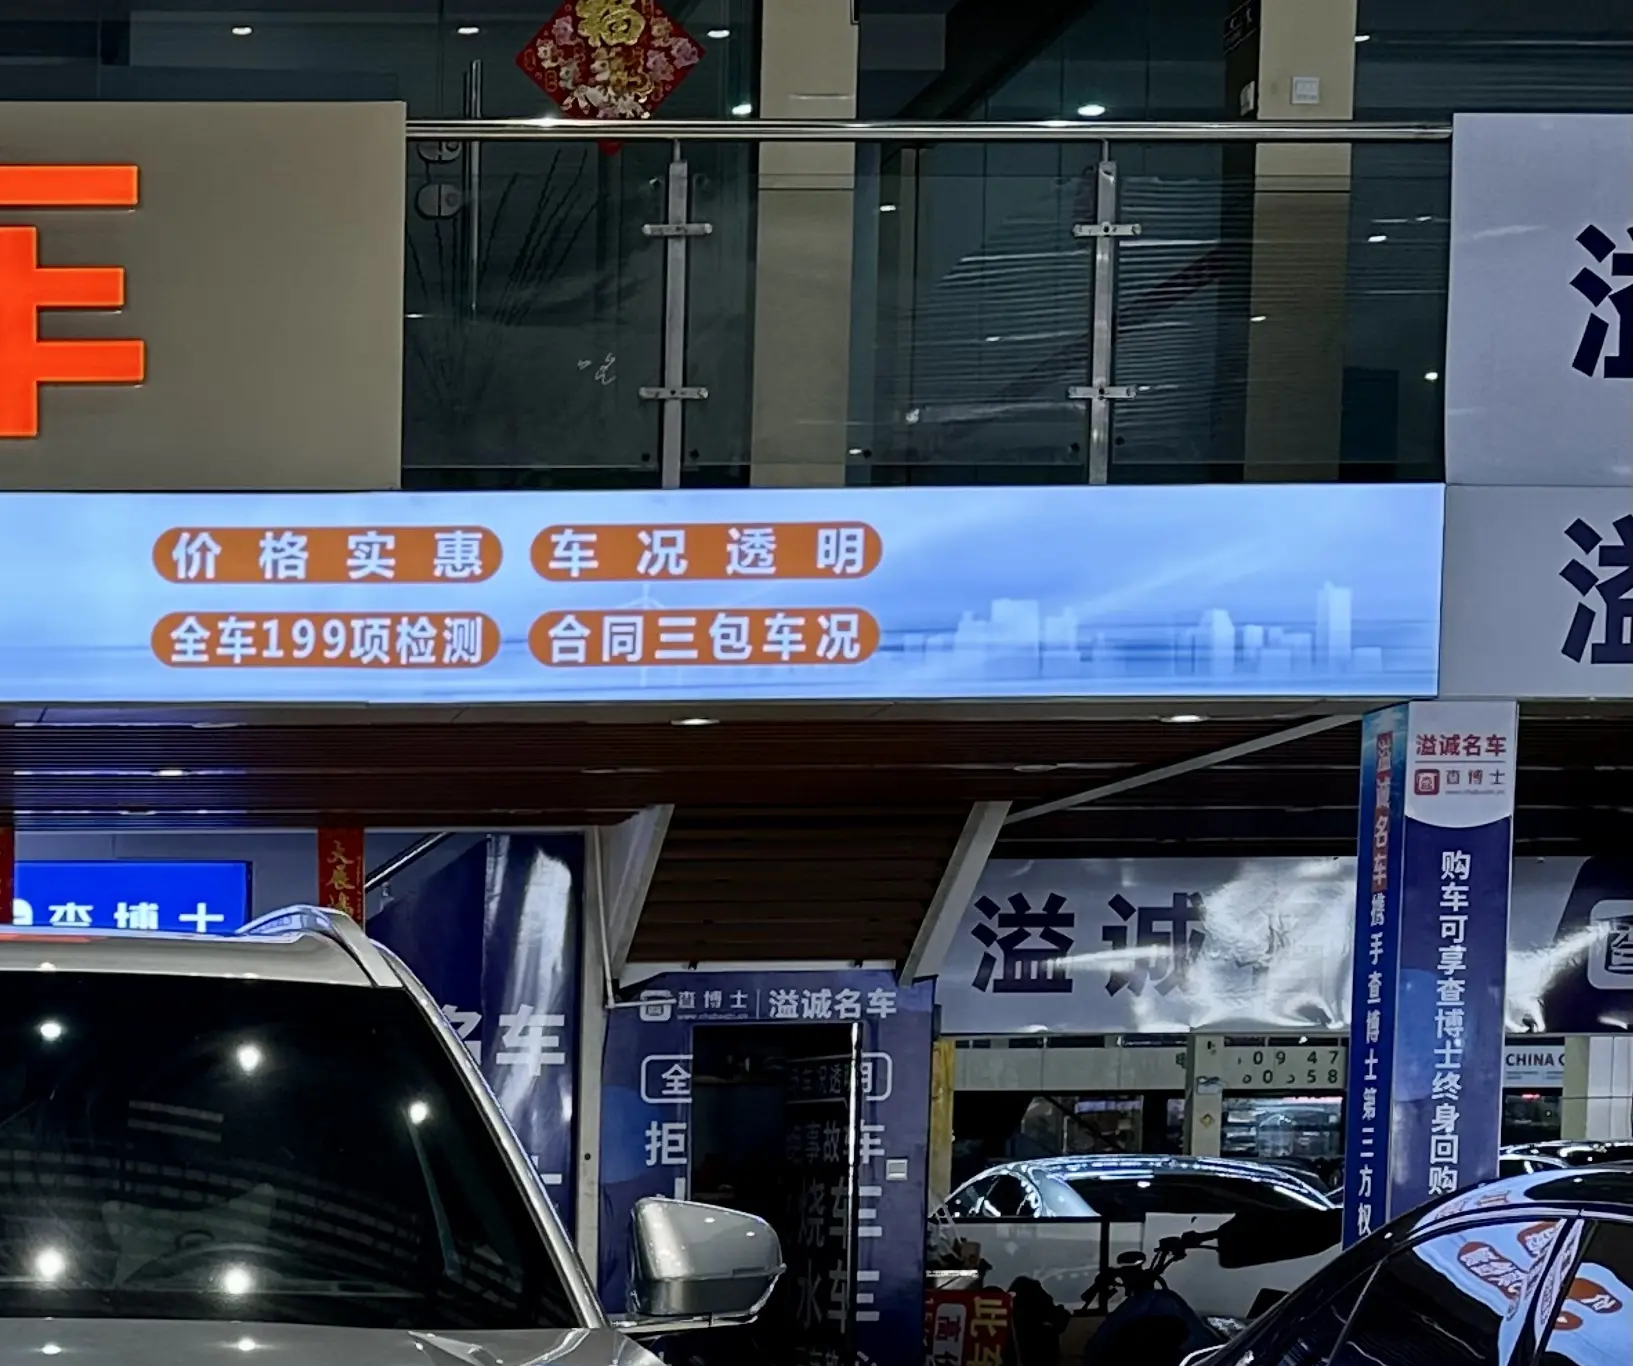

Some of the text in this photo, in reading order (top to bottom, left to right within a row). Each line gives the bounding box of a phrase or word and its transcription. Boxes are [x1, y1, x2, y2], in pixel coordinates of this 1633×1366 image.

[172, 531, 483, 579] 价格实惠
[549, 528, 865, 577] 车况透明
[170, 614, 484, 665] 全车199项检测
[548, 612, 861, 661] 合同三包车况
[1415, 733, 1507, 757] 溢诚名车
[769, 987, 898, 1019] 溢诚名车
[1428, 850, 1471, 1196] 购车可享查博士终身回购
[1505, 1053, 1555, 1066] CHINA
